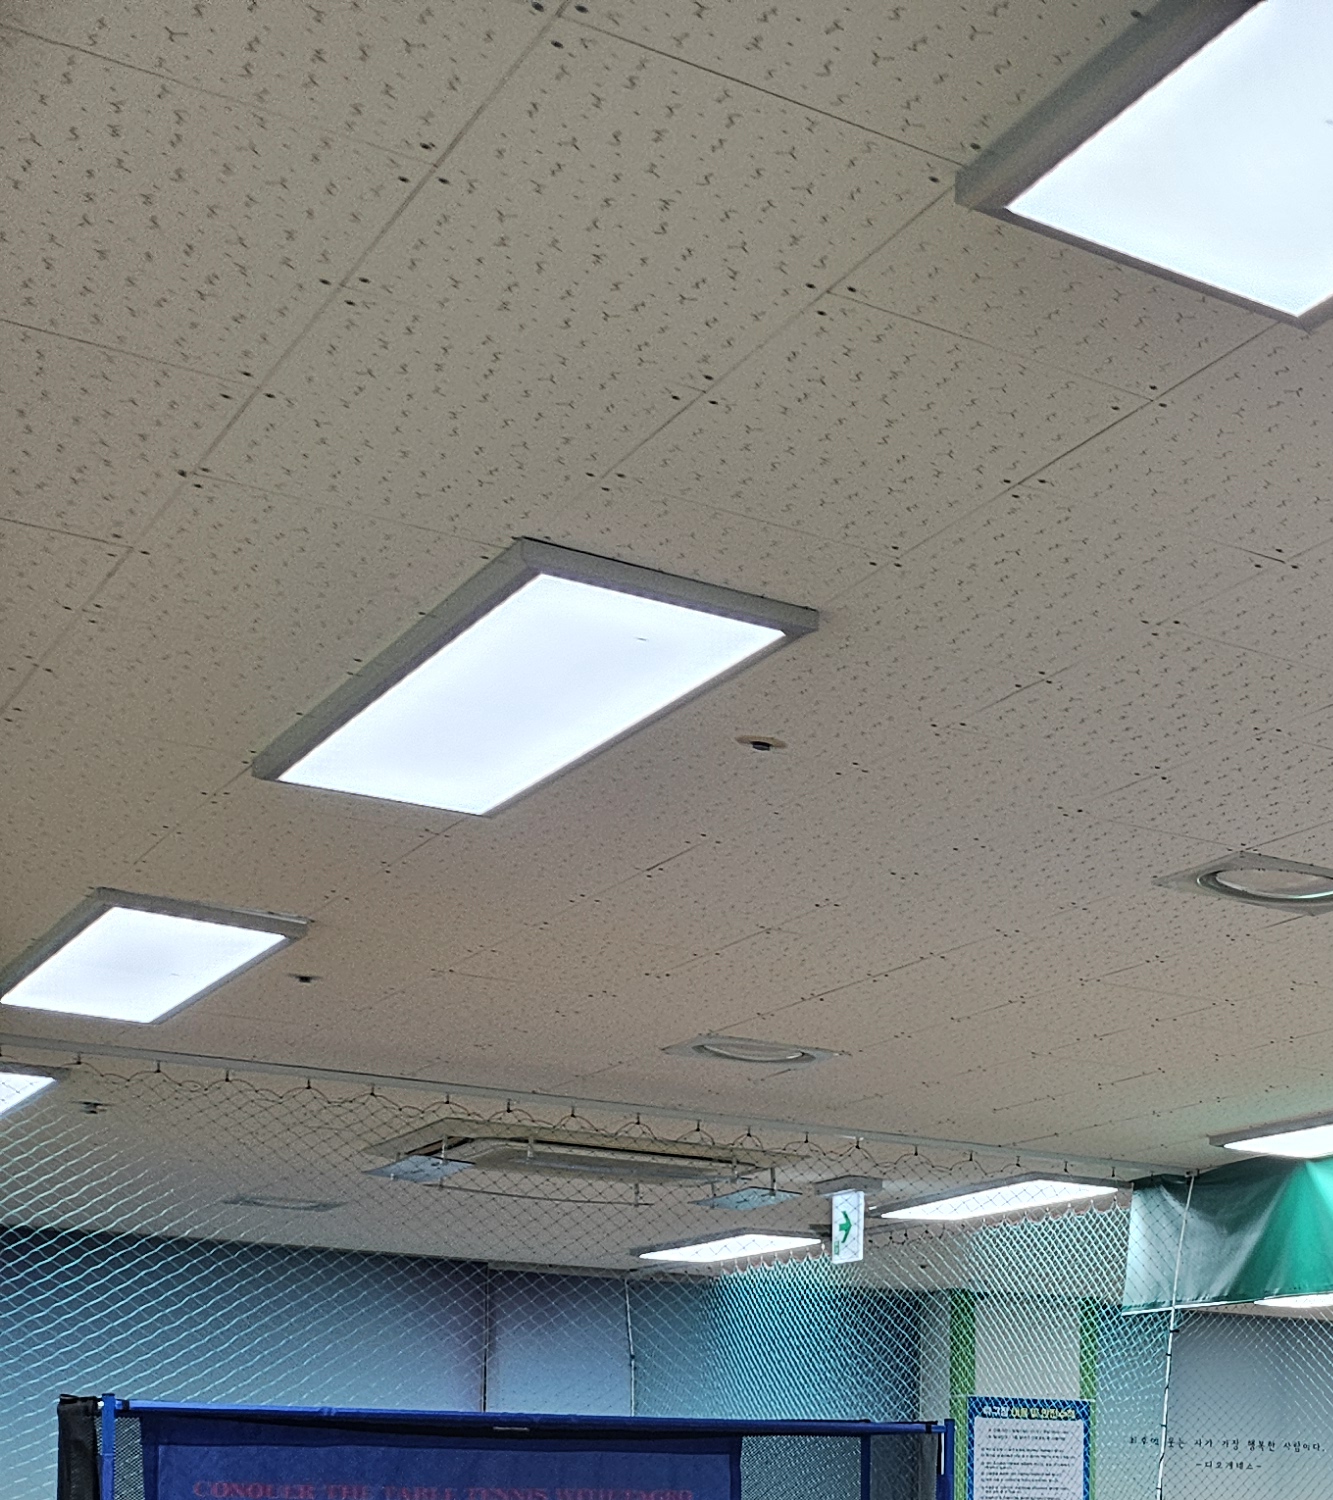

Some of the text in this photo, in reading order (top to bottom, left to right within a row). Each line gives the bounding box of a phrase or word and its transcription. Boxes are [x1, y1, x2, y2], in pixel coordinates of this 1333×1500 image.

[1221, 1438, 1239, 1450] 가장
[1248, 1440, 1276, 1452] 행복한
[1283, 1442, 1325, 1452] 사람이다.
